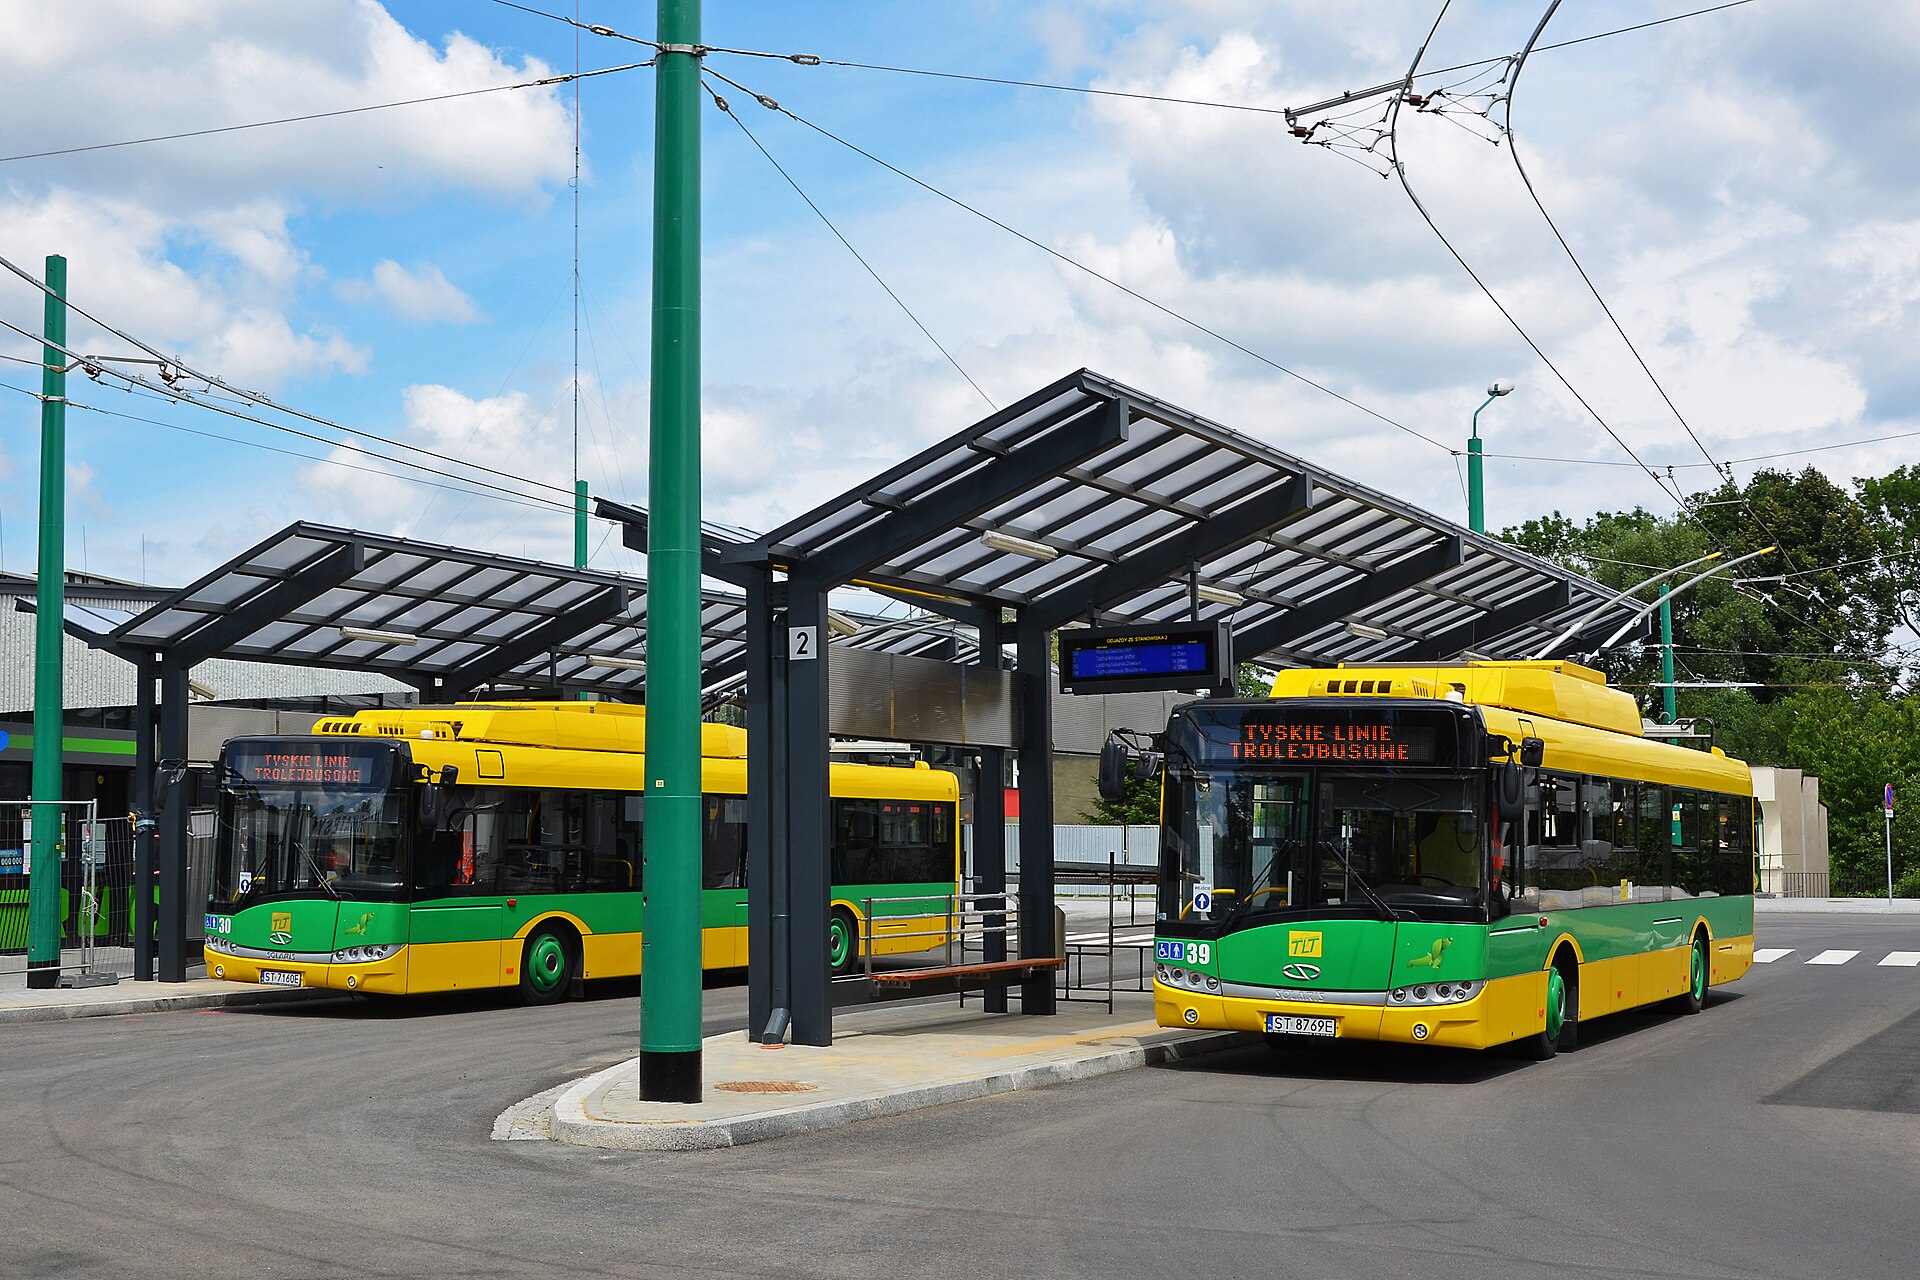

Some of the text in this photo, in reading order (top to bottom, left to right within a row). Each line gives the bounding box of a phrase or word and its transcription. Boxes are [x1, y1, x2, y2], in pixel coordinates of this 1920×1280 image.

[796, 631, 809, 655] 2
[1244, 724, 1391, 741] TYSKIE LINIE
[1229, 742, 1409, 760] TROLEJBUSOWE
[265, 754, 350, 768] TYSKIE LINIE
[255, 767, 360, 782] TROLEJBUSOWE
[218, 917, 232, 934] 30
[273, 917, 290, 930] TLT
[1187, 943, 1210, 965] 39
[1291, 937, 1320, 955] TLT
[266, 951, 296, 961] SOLARIS
[265, 972, 299, 984] ST 7160E
[1274, 1017, 1292, 1030] ST
[1295, 1018, 1334, 1033] 8769E
